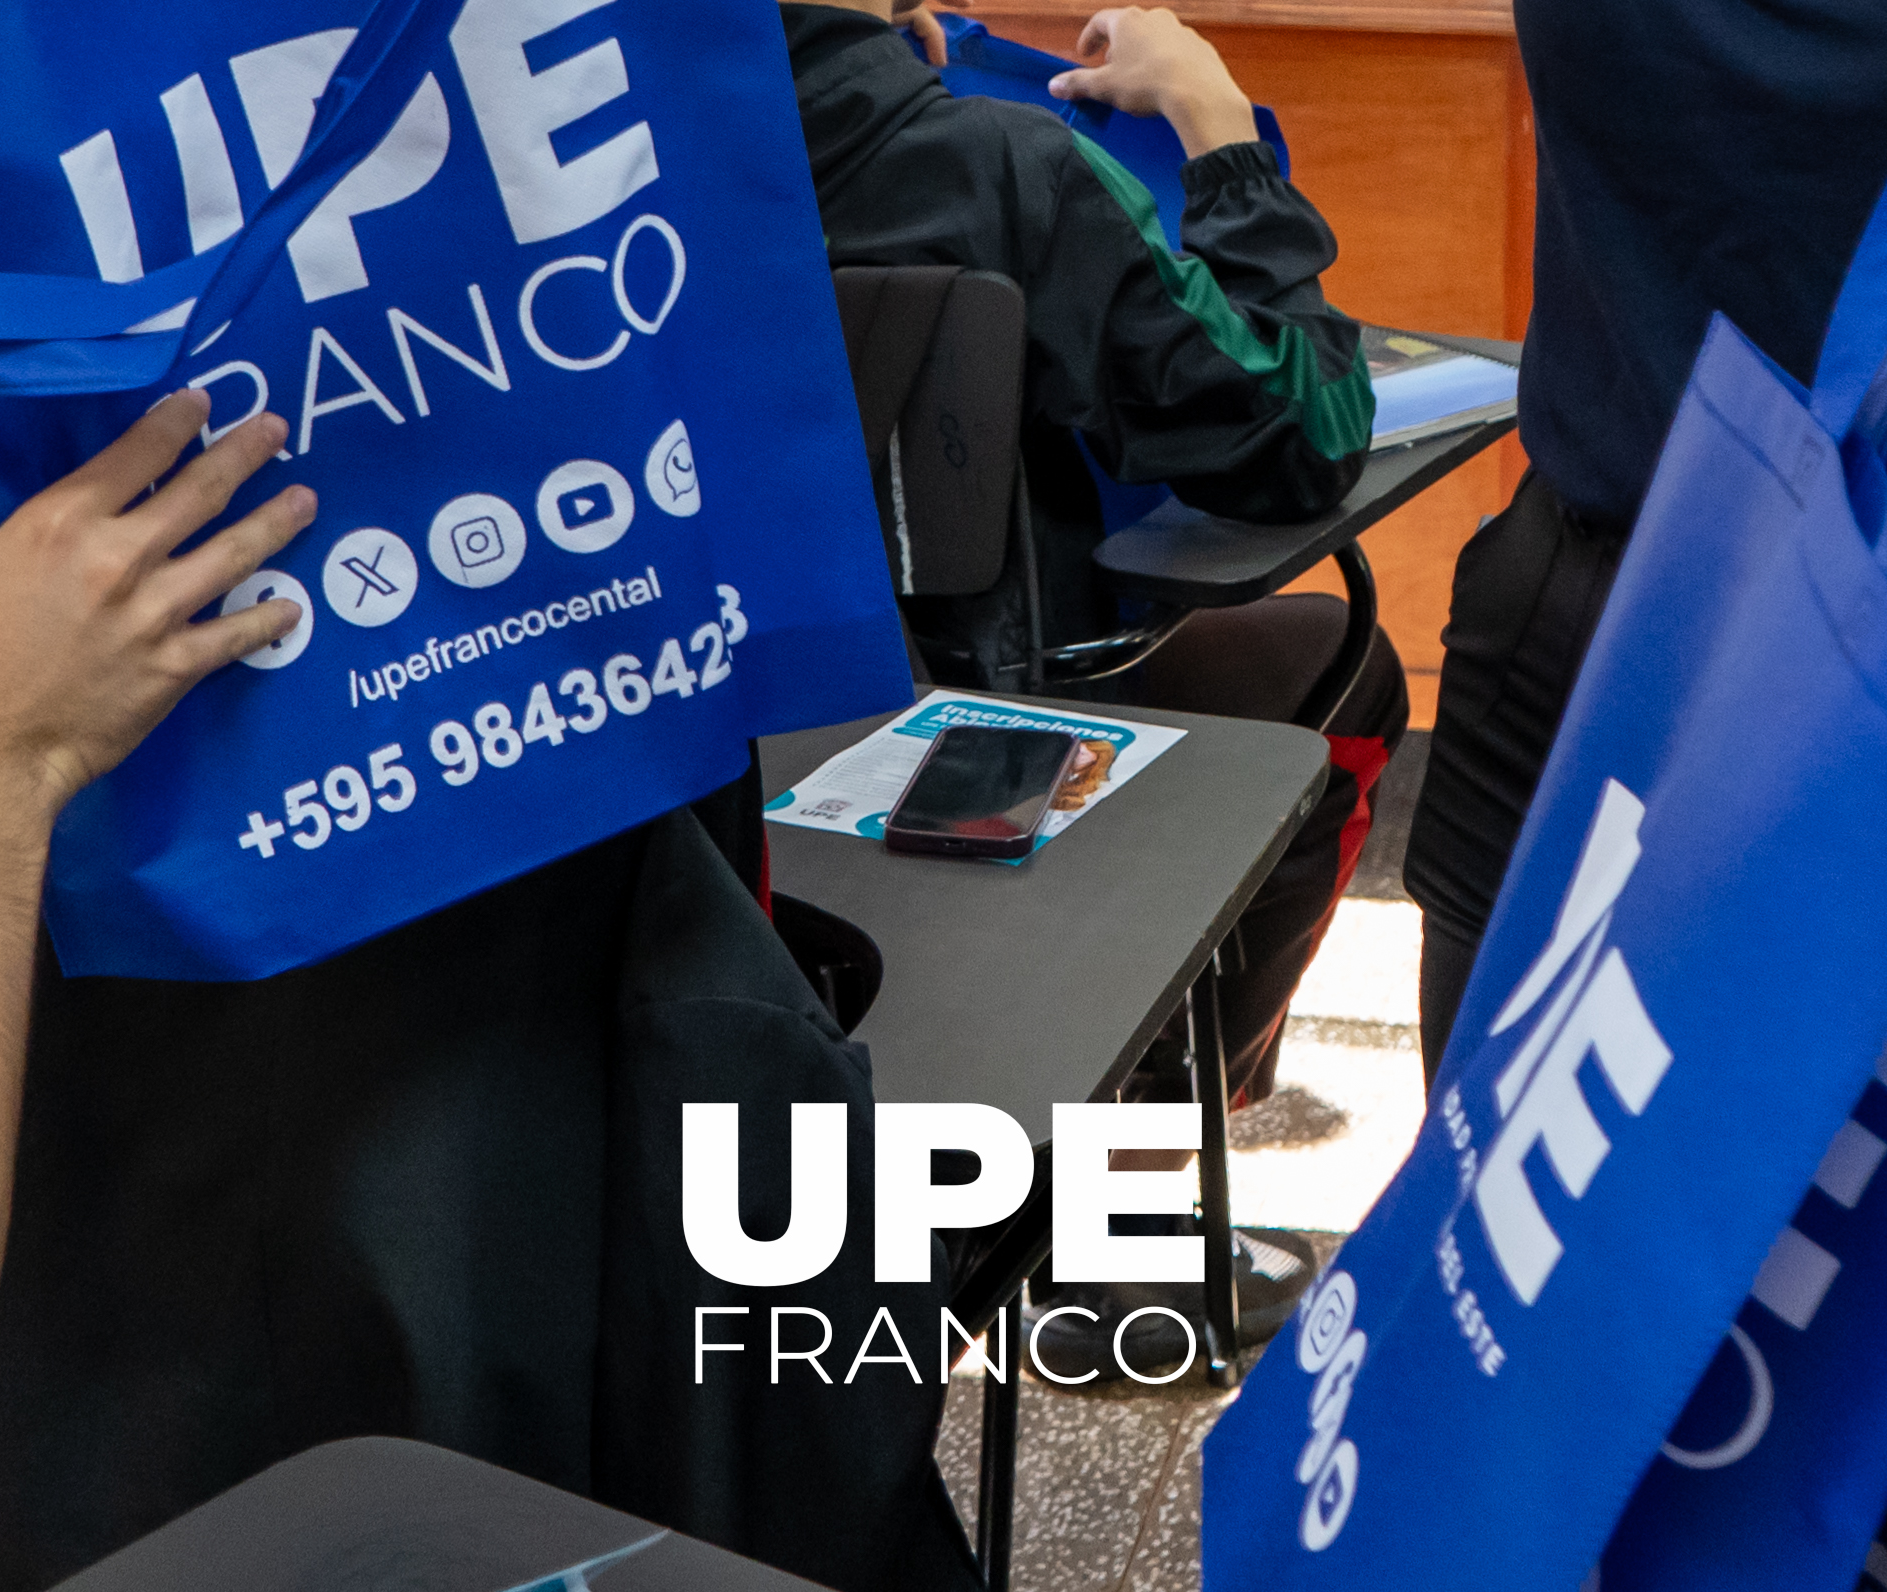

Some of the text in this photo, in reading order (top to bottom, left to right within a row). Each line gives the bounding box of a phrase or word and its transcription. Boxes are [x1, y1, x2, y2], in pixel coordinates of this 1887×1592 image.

[149, 213, 687, 493] RANCO
[348, 567, 662, 708] /upefrancocental
[238, 743, 418, 859] +595
[799, 807, 841, 823] UPE
[1453, 1287, 1508, 1378] ESTE
